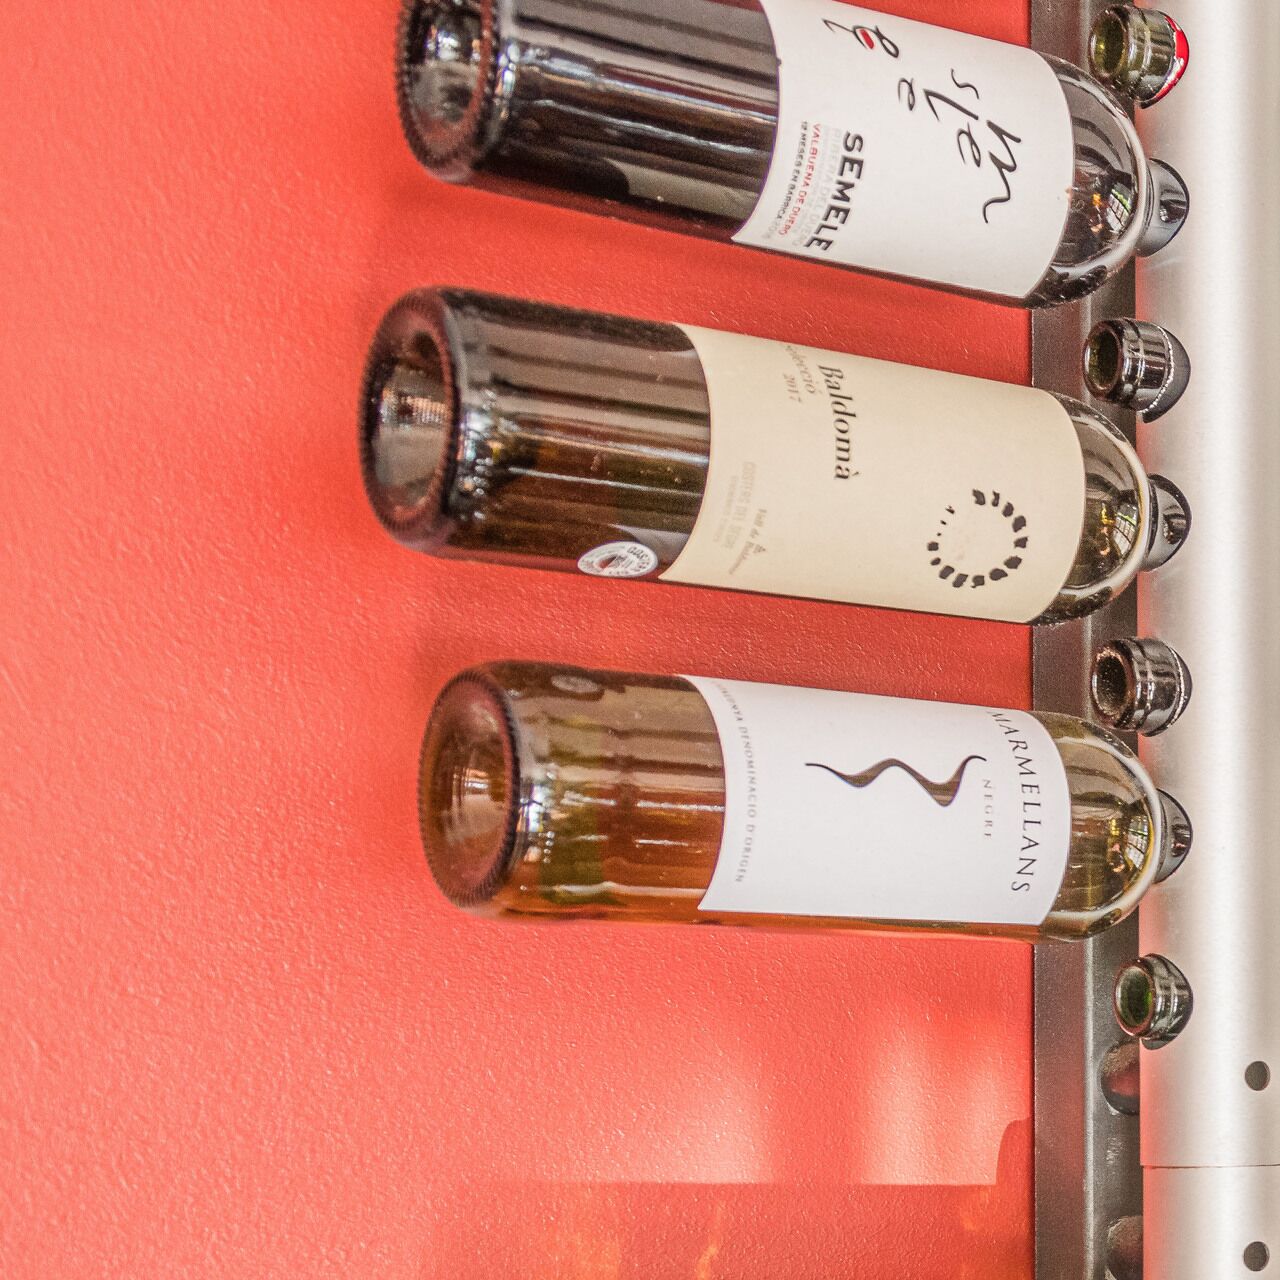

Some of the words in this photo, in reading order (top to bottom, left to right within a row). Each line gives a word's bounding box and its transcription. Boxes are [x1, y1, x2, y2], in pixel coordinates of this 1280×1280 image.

[794, 188, 808, 205] DE
[800, 122, 819, 185] VALBUENA
[804, 131, 864, 254] SEMELE
[815, 363, 860, 481] Baldomà
[981, 777, 994, 841] NEGRE
[985, 710, 1041, 893] MARMELLANS
